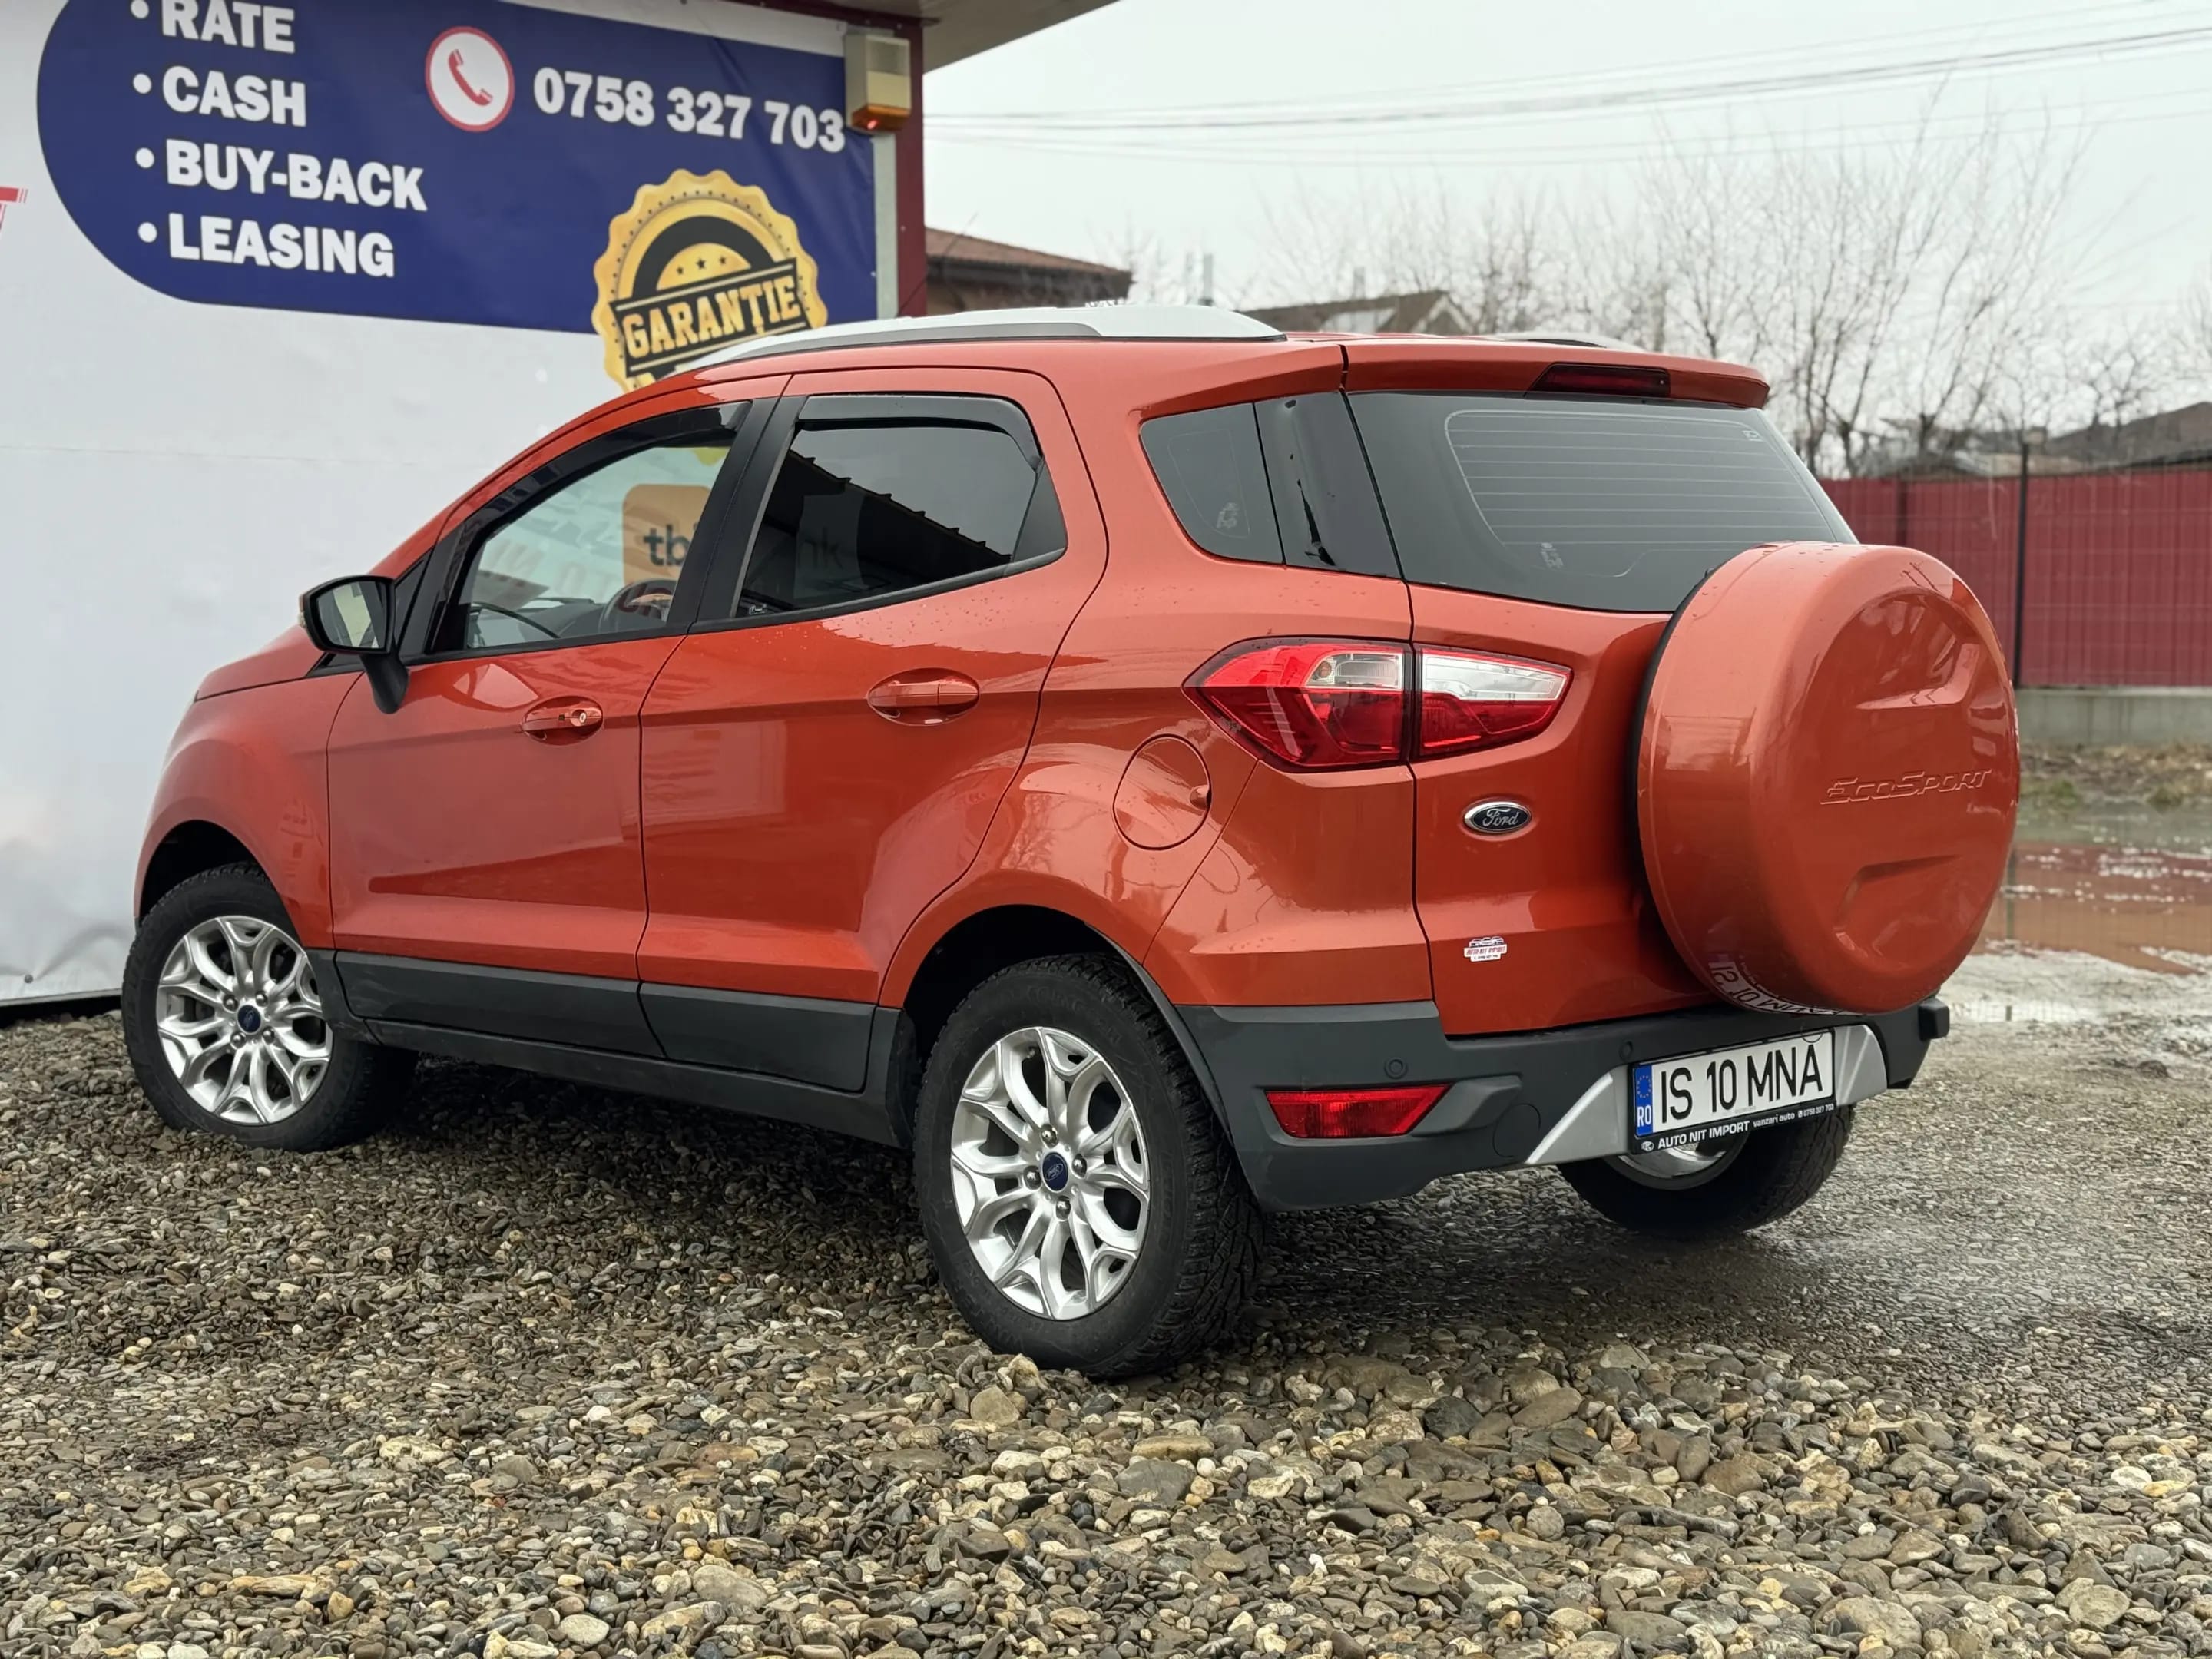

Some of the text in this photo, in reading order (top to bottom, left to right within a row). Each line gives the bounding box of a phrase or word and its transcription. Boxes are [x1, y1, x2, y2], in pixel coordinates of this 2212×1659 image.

[161, 0, 295, 54] RATE
[162, 65, 307, 127] CASH
[533, 66, 846, 153] 0758 327 703
[165, 138, 428, 212] BUY-BACK
[168, 212, 395, 278] LEASING
[1482, 807, 1519, 827] Ford
[1661, 1044, 1823, 1124] IS 10 MNA
[1637, 1106, 1651, 1128] RO
[1657, 1133, 1687, 1150] AUTO
[1690, 1129, 1707, 1143] NIT
[1709, 1120, 1750, 1138] IMPORT
[1778, 1111, 1796, 1122] auto
